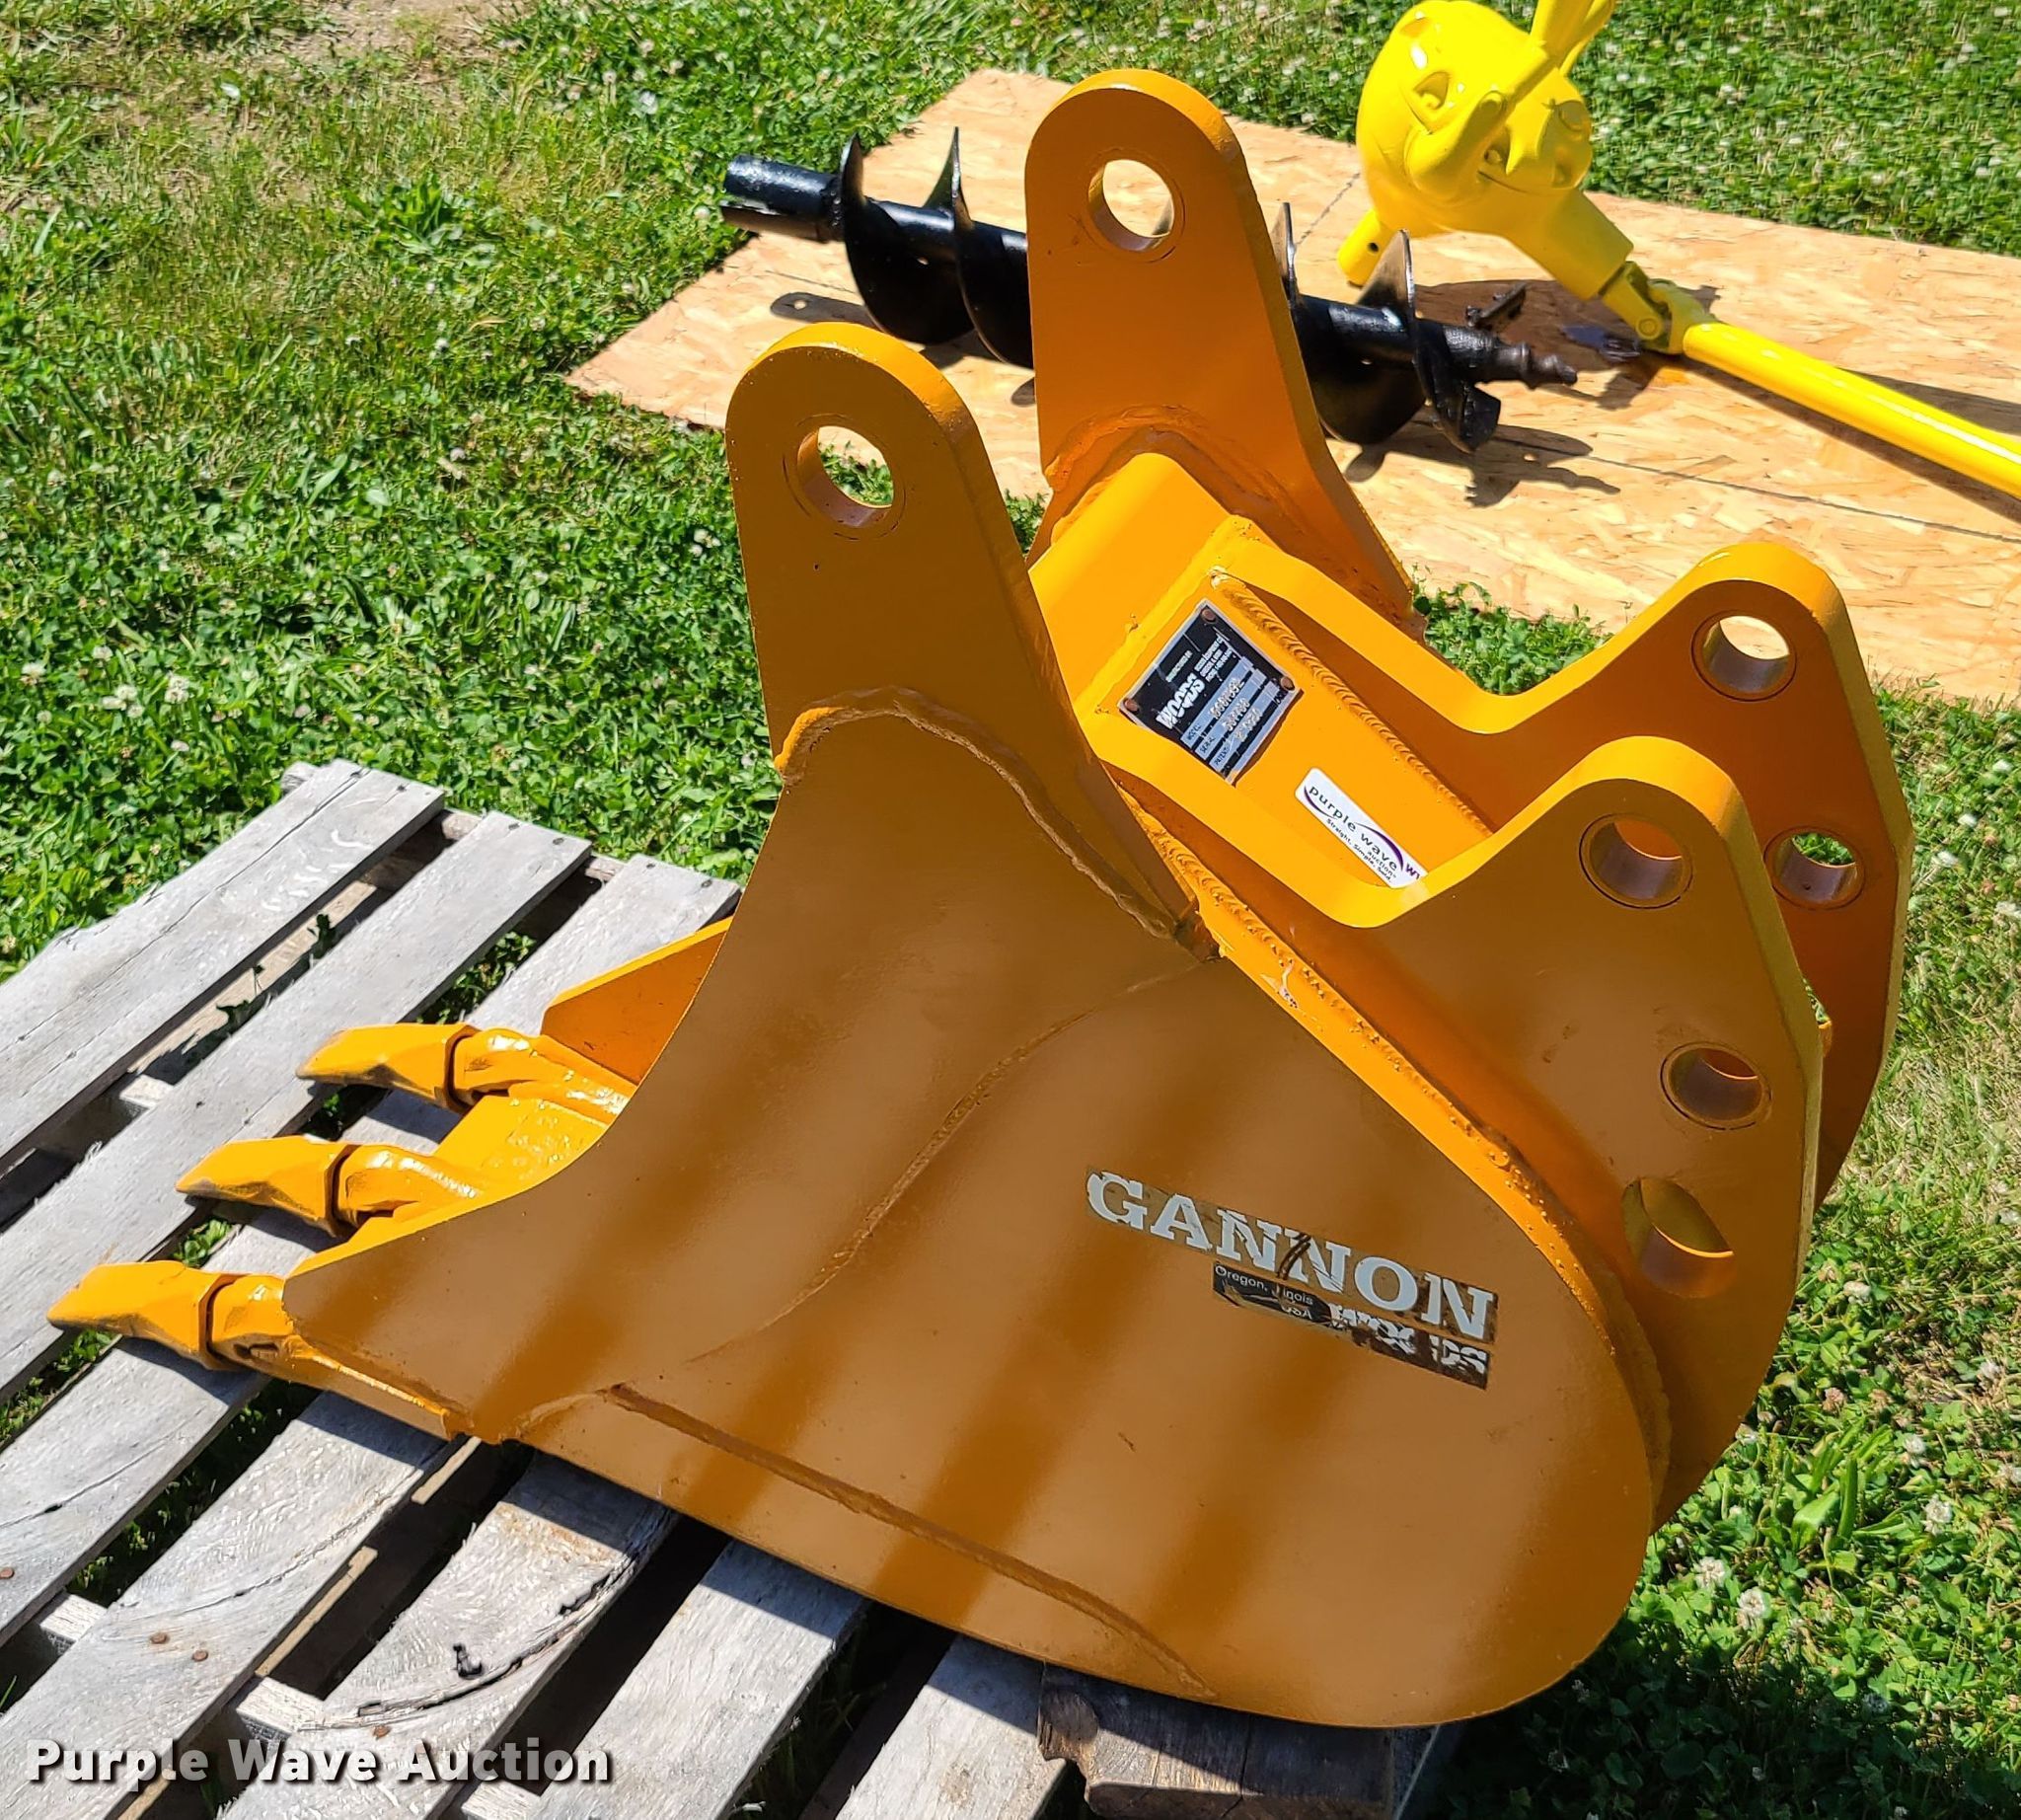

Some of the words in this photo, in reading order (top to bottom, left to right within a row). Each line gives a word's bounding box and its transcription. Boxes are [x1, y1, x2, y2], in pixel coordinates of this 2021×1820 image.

[1156, 672, 1206, 729] WOODS
[1309, 786, 1356, 832] purple
[1360, 833, 1397, 871] wave
[1086, 1172, 1492, 1339] GANNON
[1328, 1303, 1487, 1374] WODS
